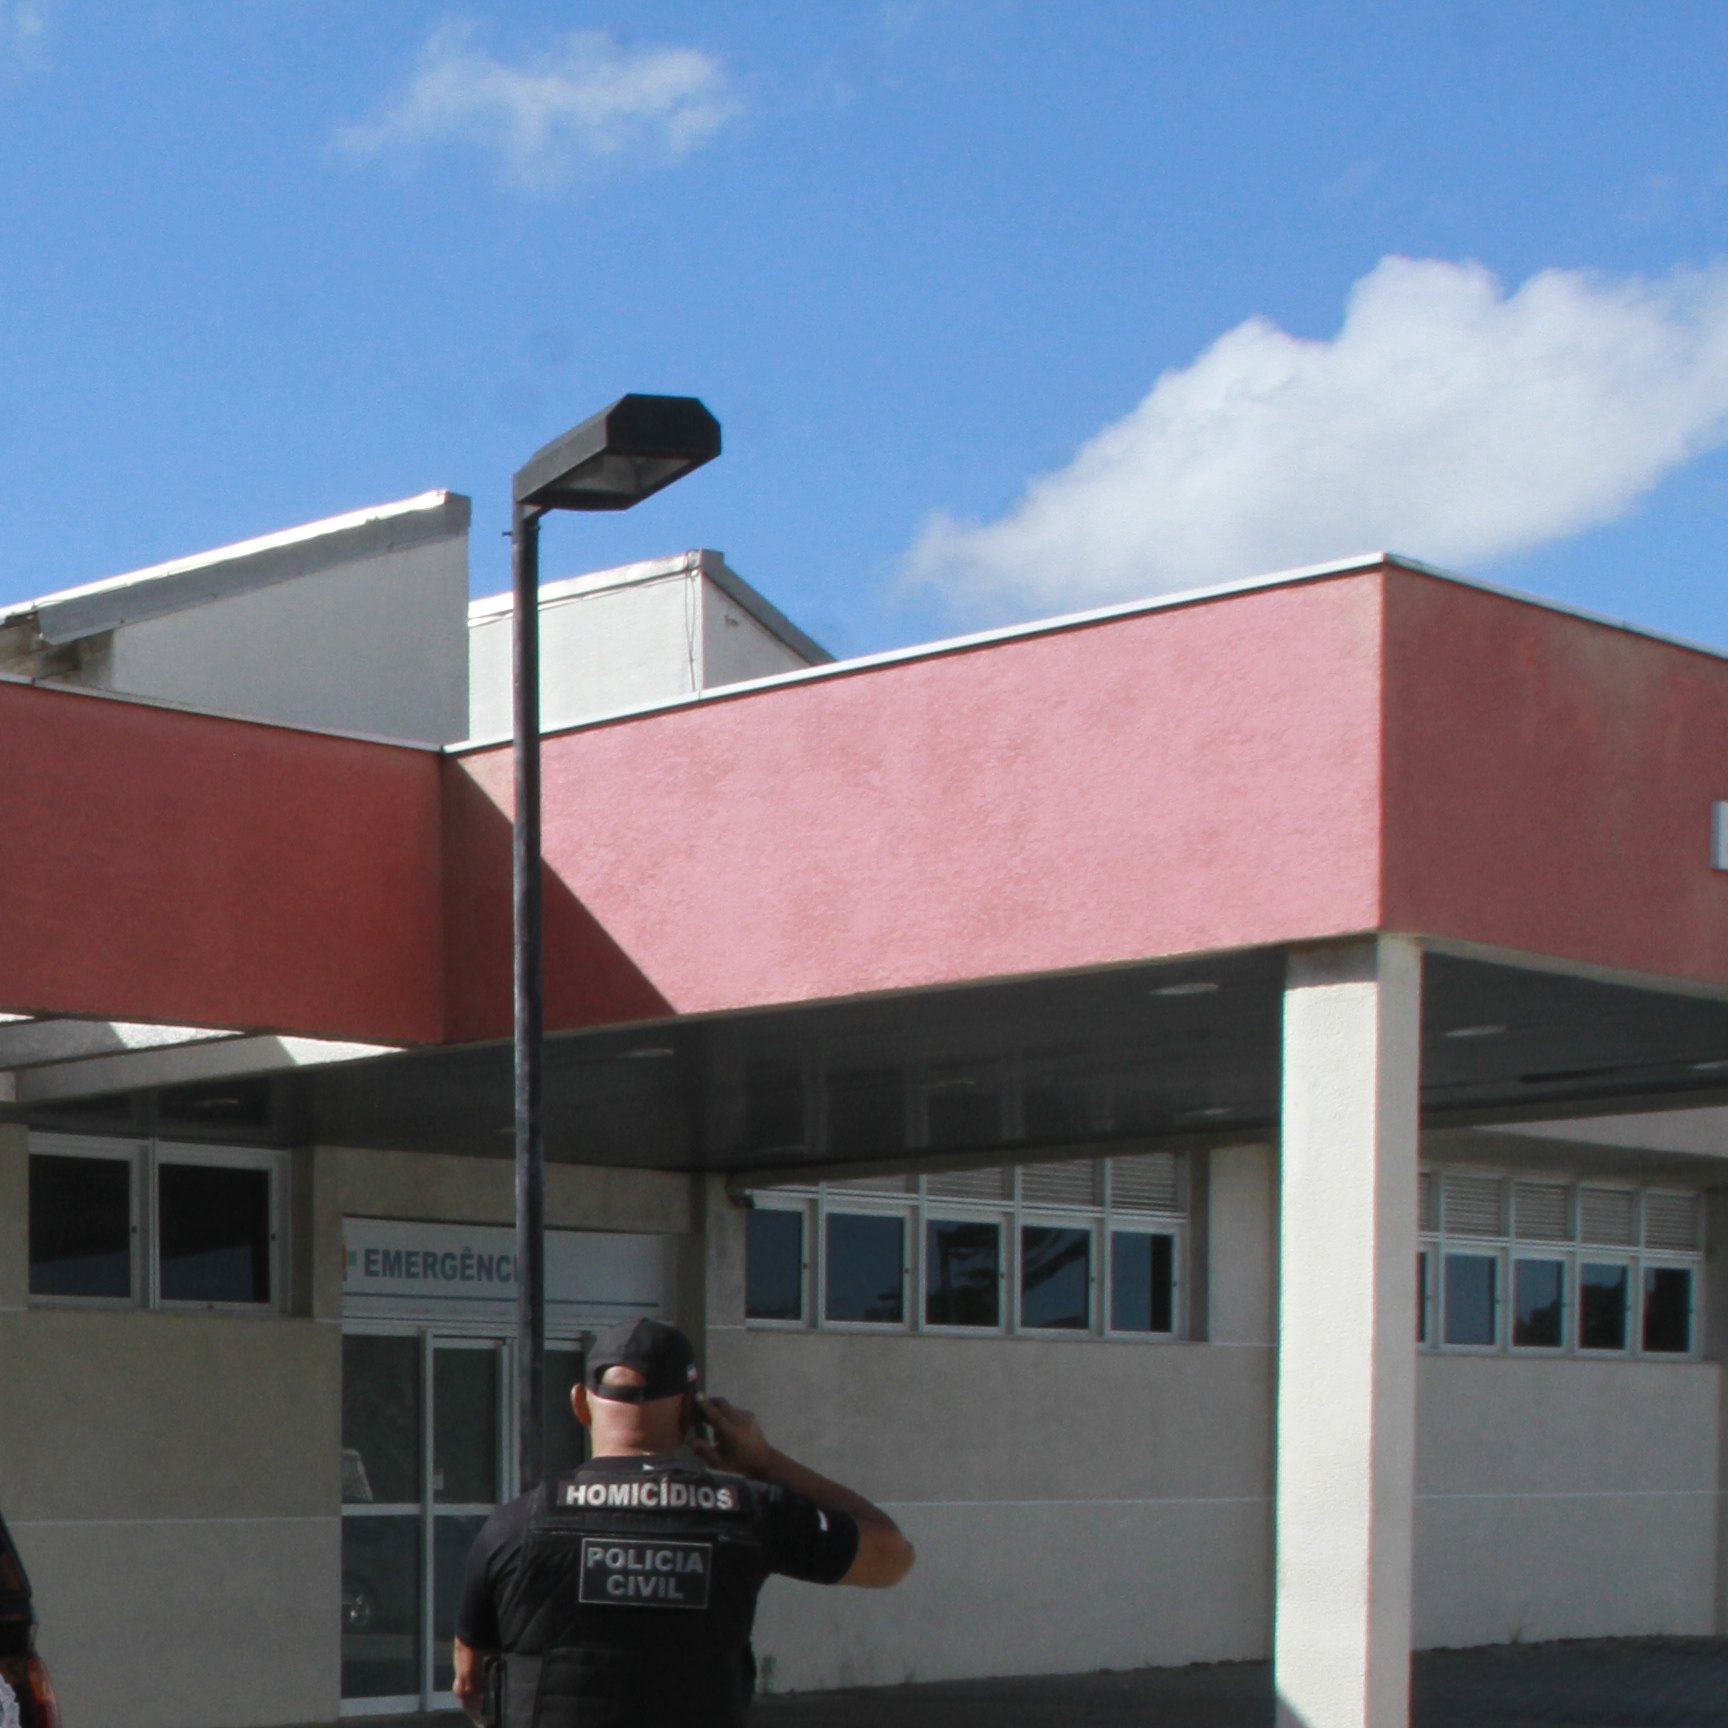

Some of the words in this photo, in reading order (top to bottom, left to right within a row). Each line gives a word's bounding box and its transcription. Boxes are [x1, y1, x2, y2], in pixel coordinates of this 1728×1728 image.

[364, 1246, 519, 1283] EMERGÊNCI
[566, 1477, 734, 1510] HOMICÍDIOS
[586, 1546, 705, 1574] POLICIA
[606, 1574, 684, 1599] CIVIL
